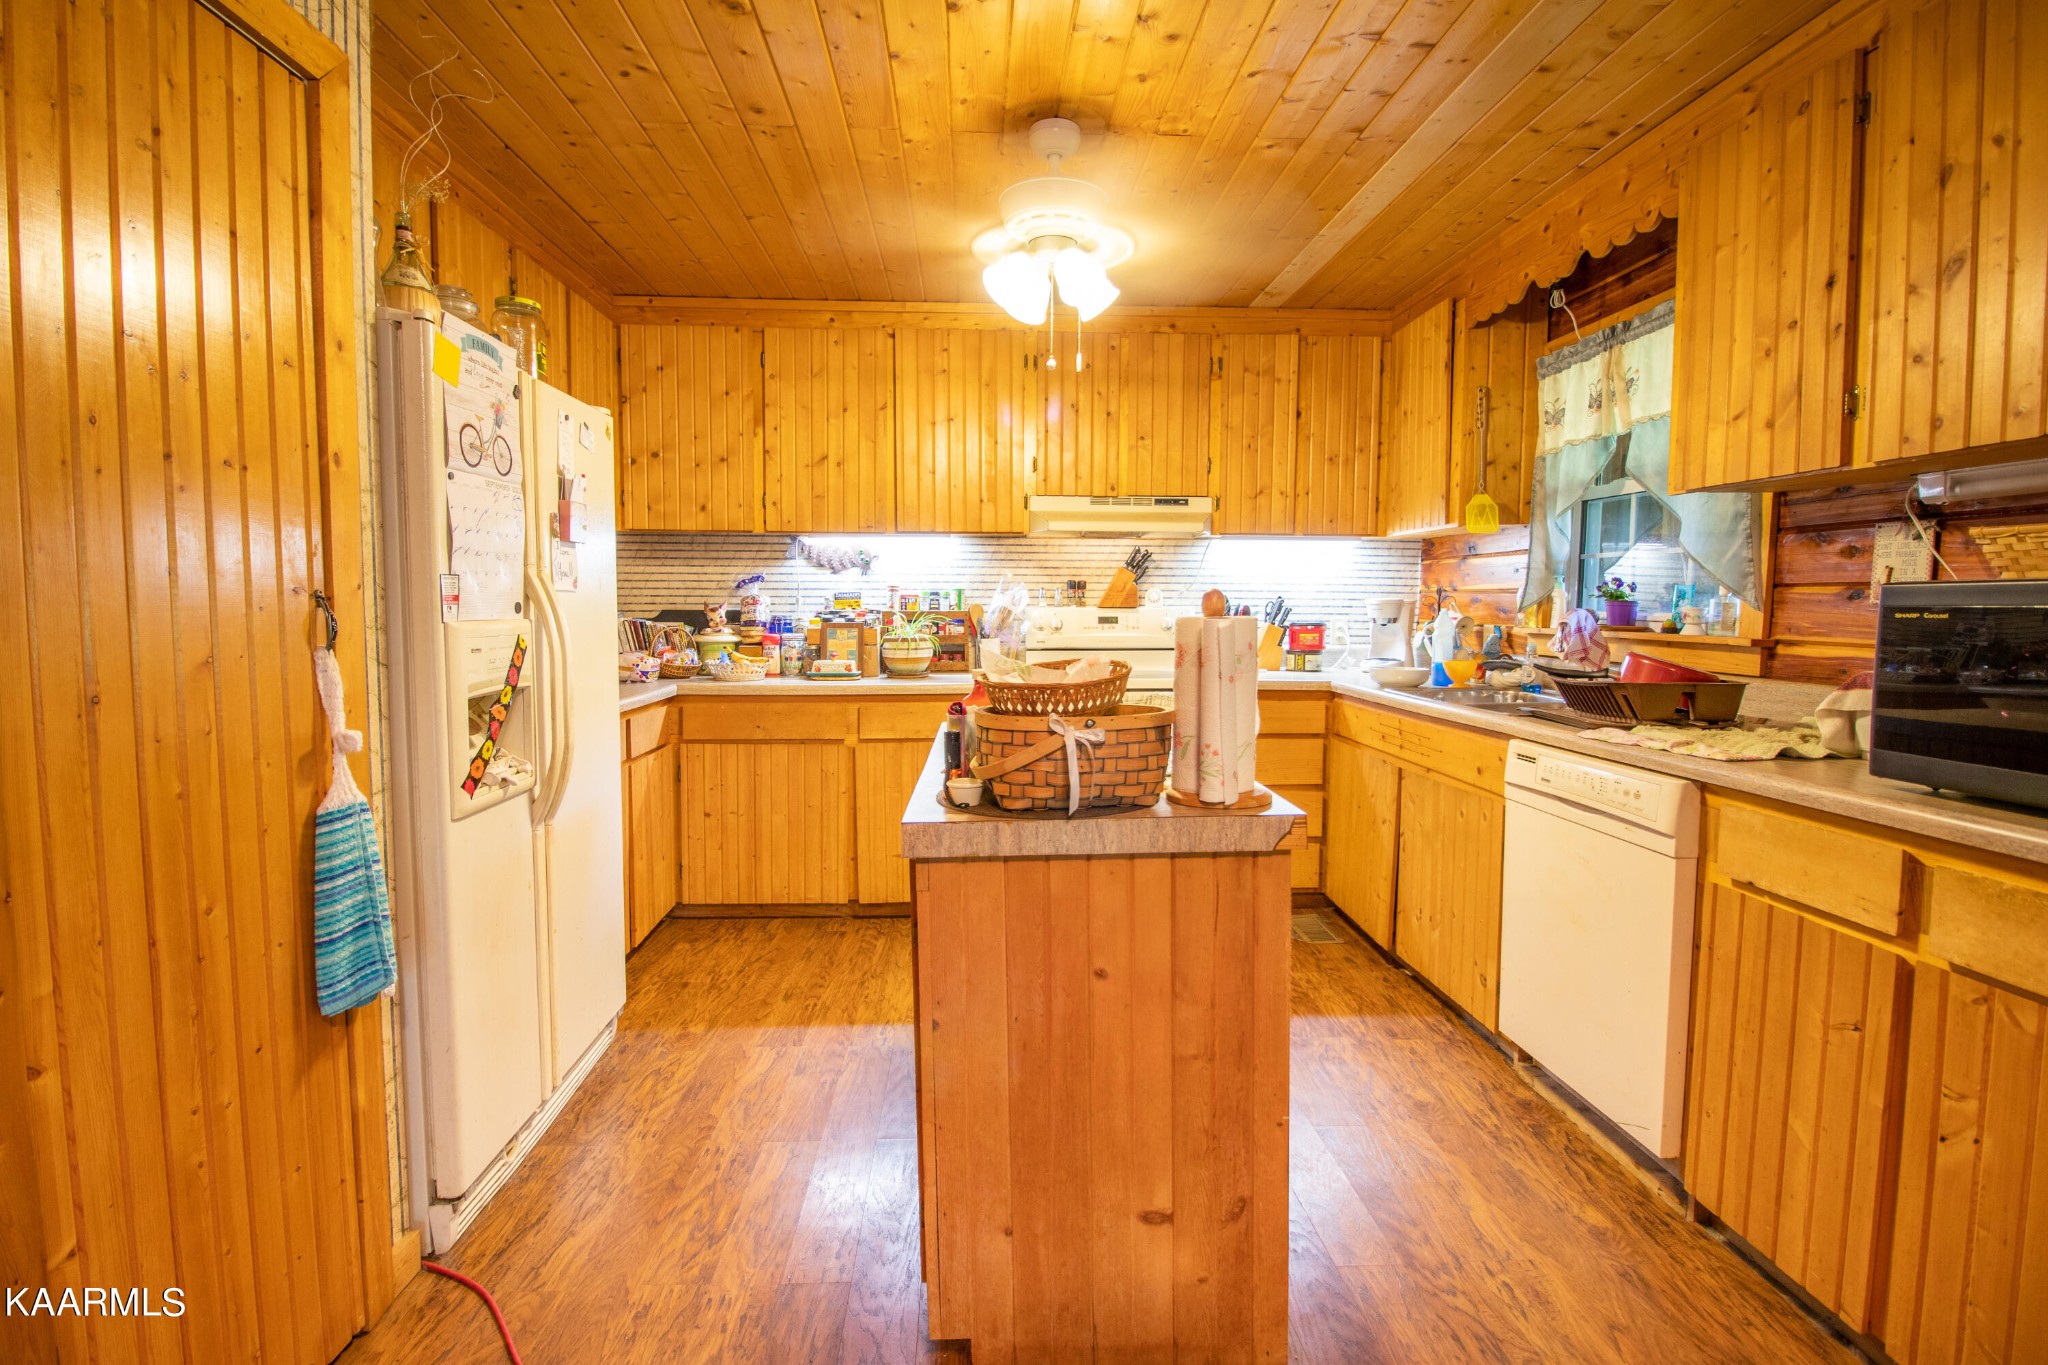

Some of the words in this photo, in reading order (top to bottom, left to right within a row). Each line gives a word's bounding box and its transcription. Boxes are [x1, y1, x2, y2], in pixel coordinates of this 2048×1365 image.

[472, 338, 495, 358] FAMILY
[1897, 541, 1911, 550] LOVE
[1895, 550, 1922, 558] PROBABLY
[1902, 559, 1918, 567] MICE
[1900, 568, 1908, 576] IN
